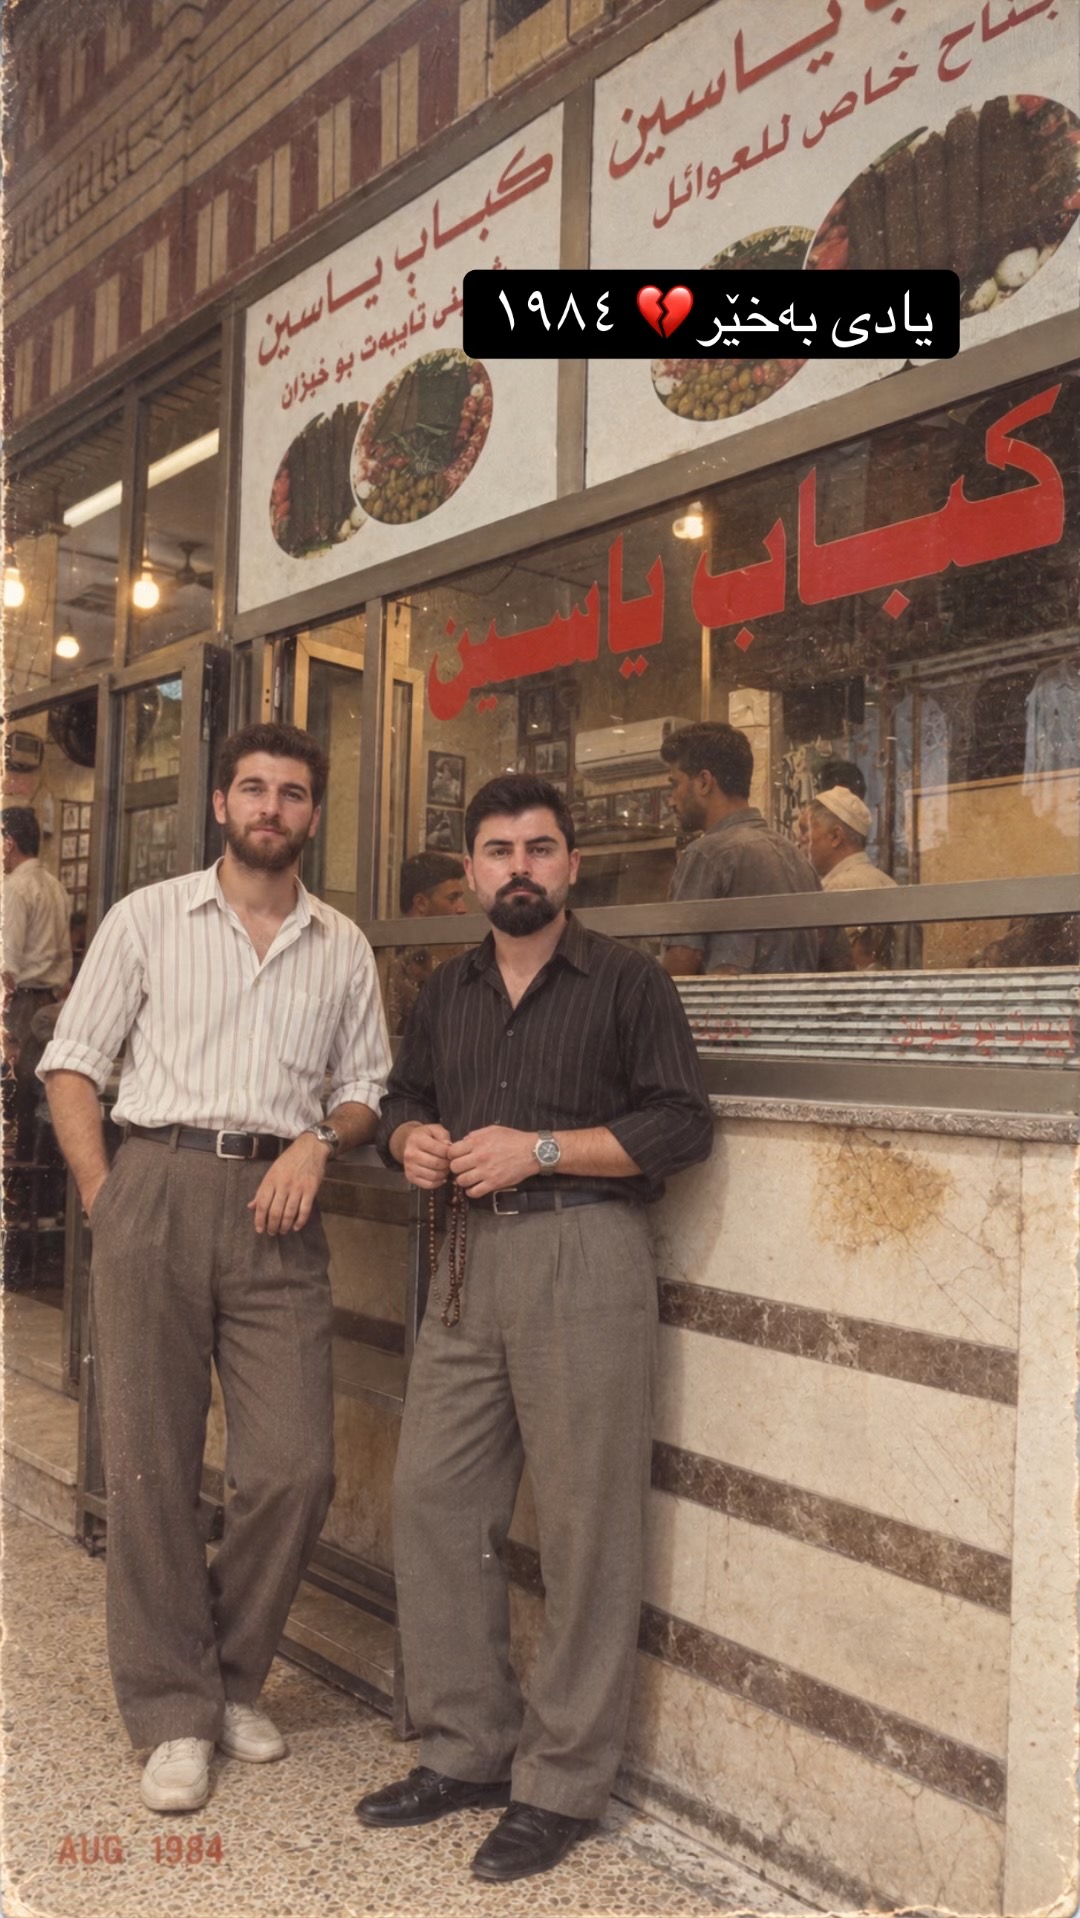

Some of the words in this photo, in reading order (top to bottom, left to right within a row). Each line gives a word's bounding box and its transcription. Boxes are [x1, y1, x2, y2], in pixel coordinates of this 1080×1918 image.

[608, 0, 842, 179] ياسين
[801, 51, 919, 149] خاص
[394, 146, 555, 285] كباب
[651, 113, 790, 229] للعوائل
[257, 256, 384, 366] ياسين
[691, 383, 1066, 653] كباب
[427, 532, 665, 721] ياسين
